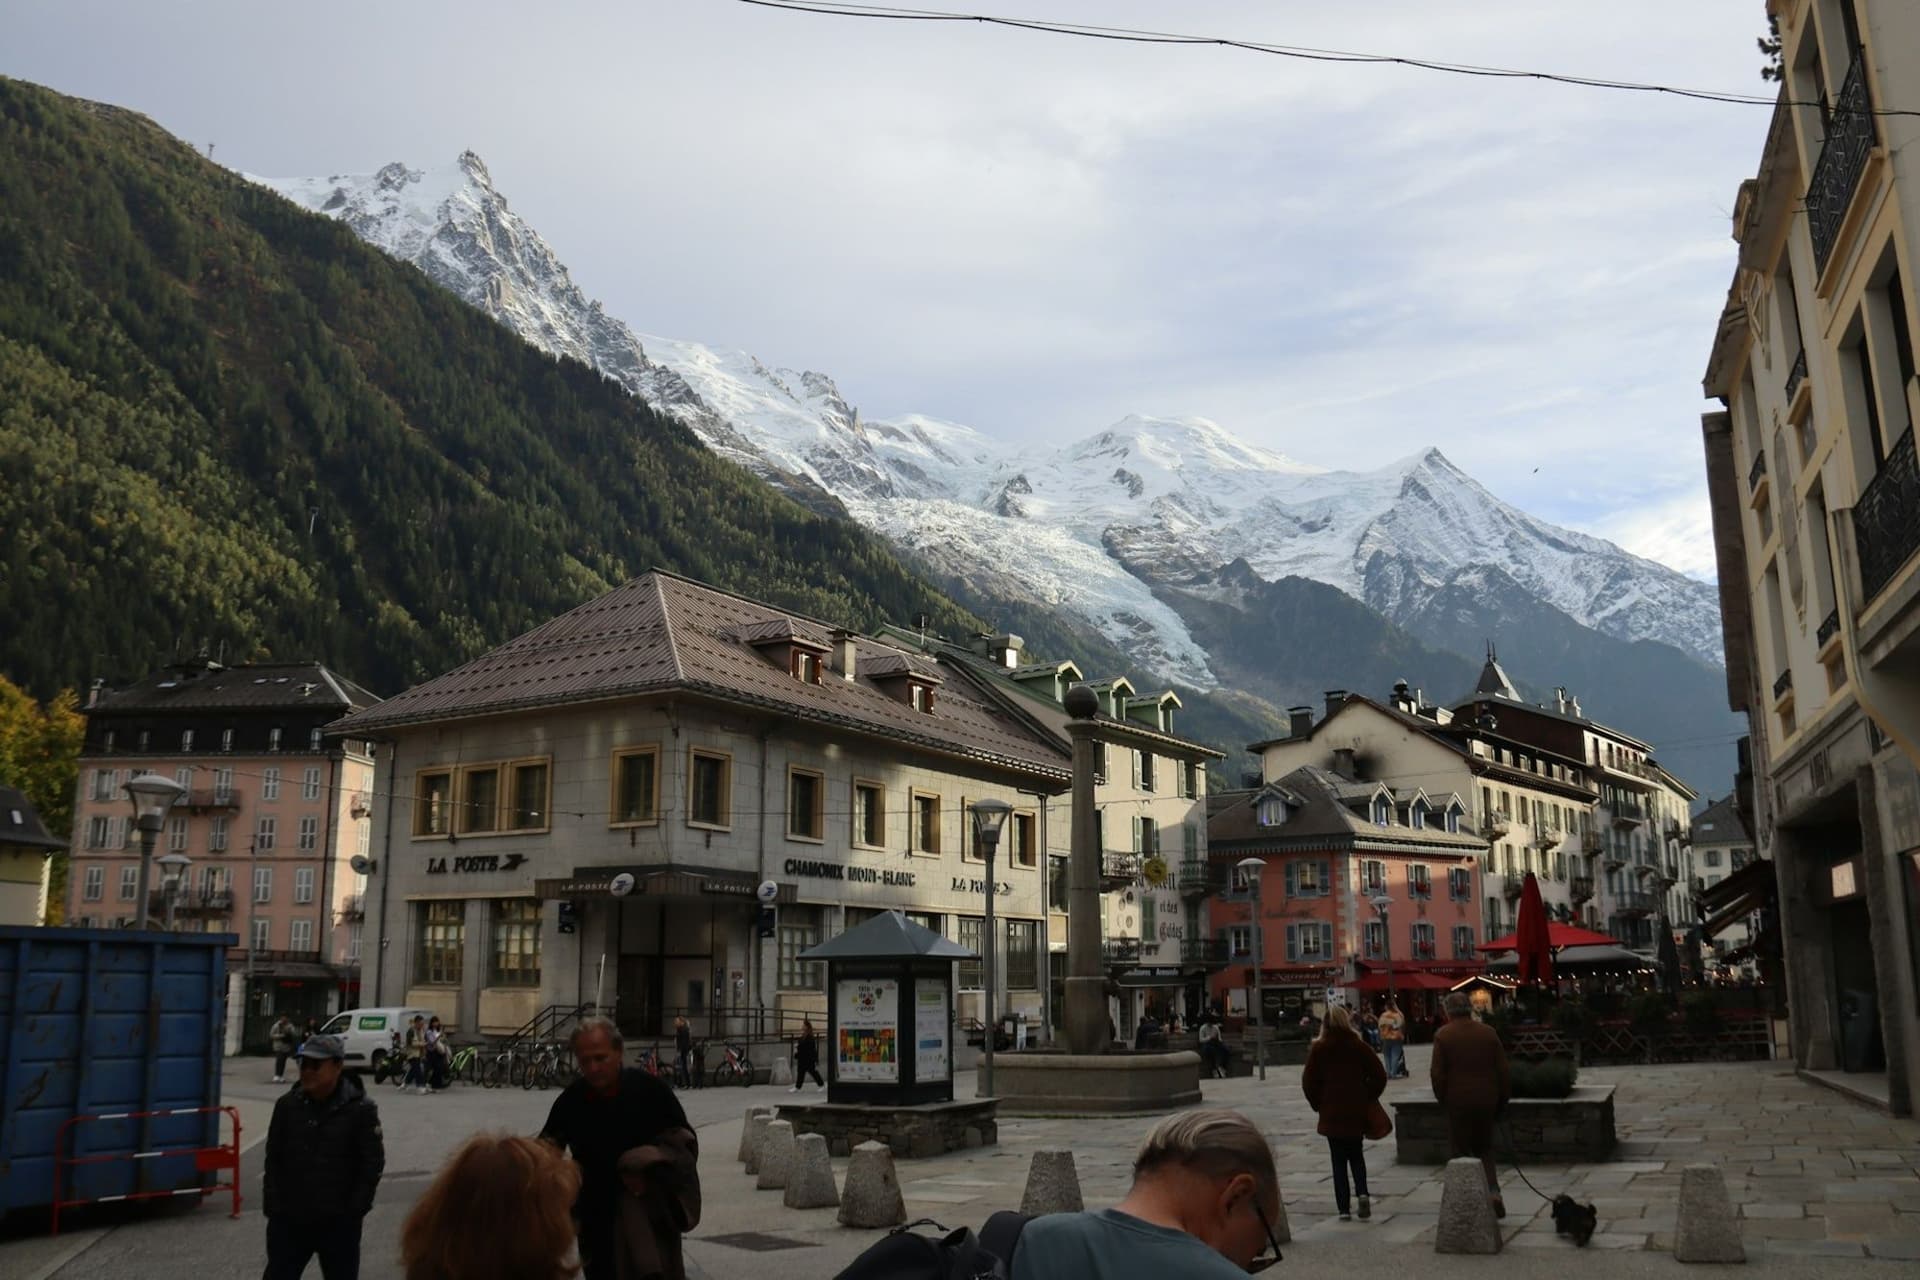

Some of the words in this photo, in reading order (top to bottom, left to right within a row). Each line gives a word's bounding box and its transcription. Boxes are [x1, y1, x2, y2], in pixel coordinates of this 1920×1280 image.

[426, 857, 448, 874] LA
[452, 855, 499, 873] POSTE
[784, 858, 844, 880] CHAMONIX
